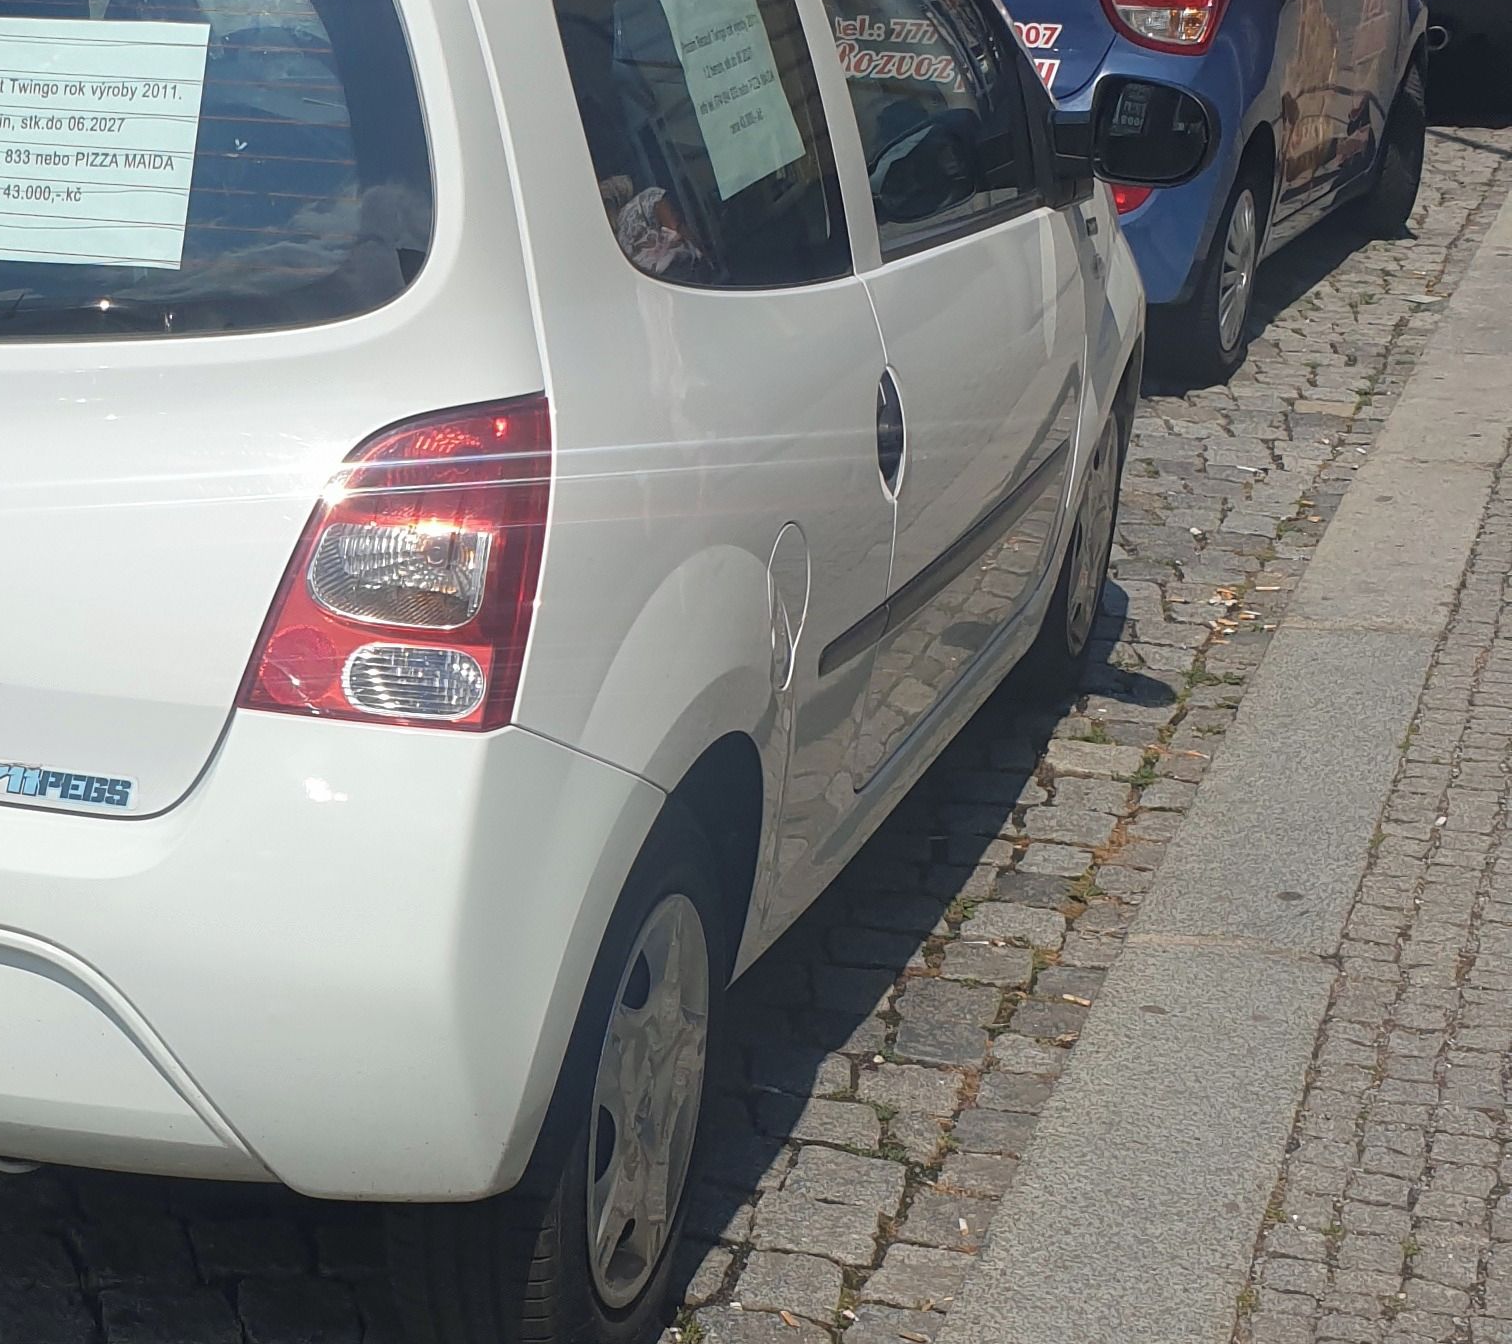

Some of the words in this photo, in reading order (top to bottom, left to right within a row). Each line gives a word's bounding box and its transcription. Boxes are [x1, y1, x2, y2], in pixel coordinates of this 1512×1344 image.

[836, 39, 955, 84] Rozvoz
[9, 77, 59, 99] Twingo
[63, 80, 86, 97] rok
[90, 80, 138, 102] výroby
[141, 82, 183, 101] 2011.
[67, 115, 126, 133] 06.2027
[4, 148, 31, 165] 833
[35, 150, 71, 167] nebo
[74, 151, 119, 168] PIZZA
[123, 153, 175, 171] MAIDA
